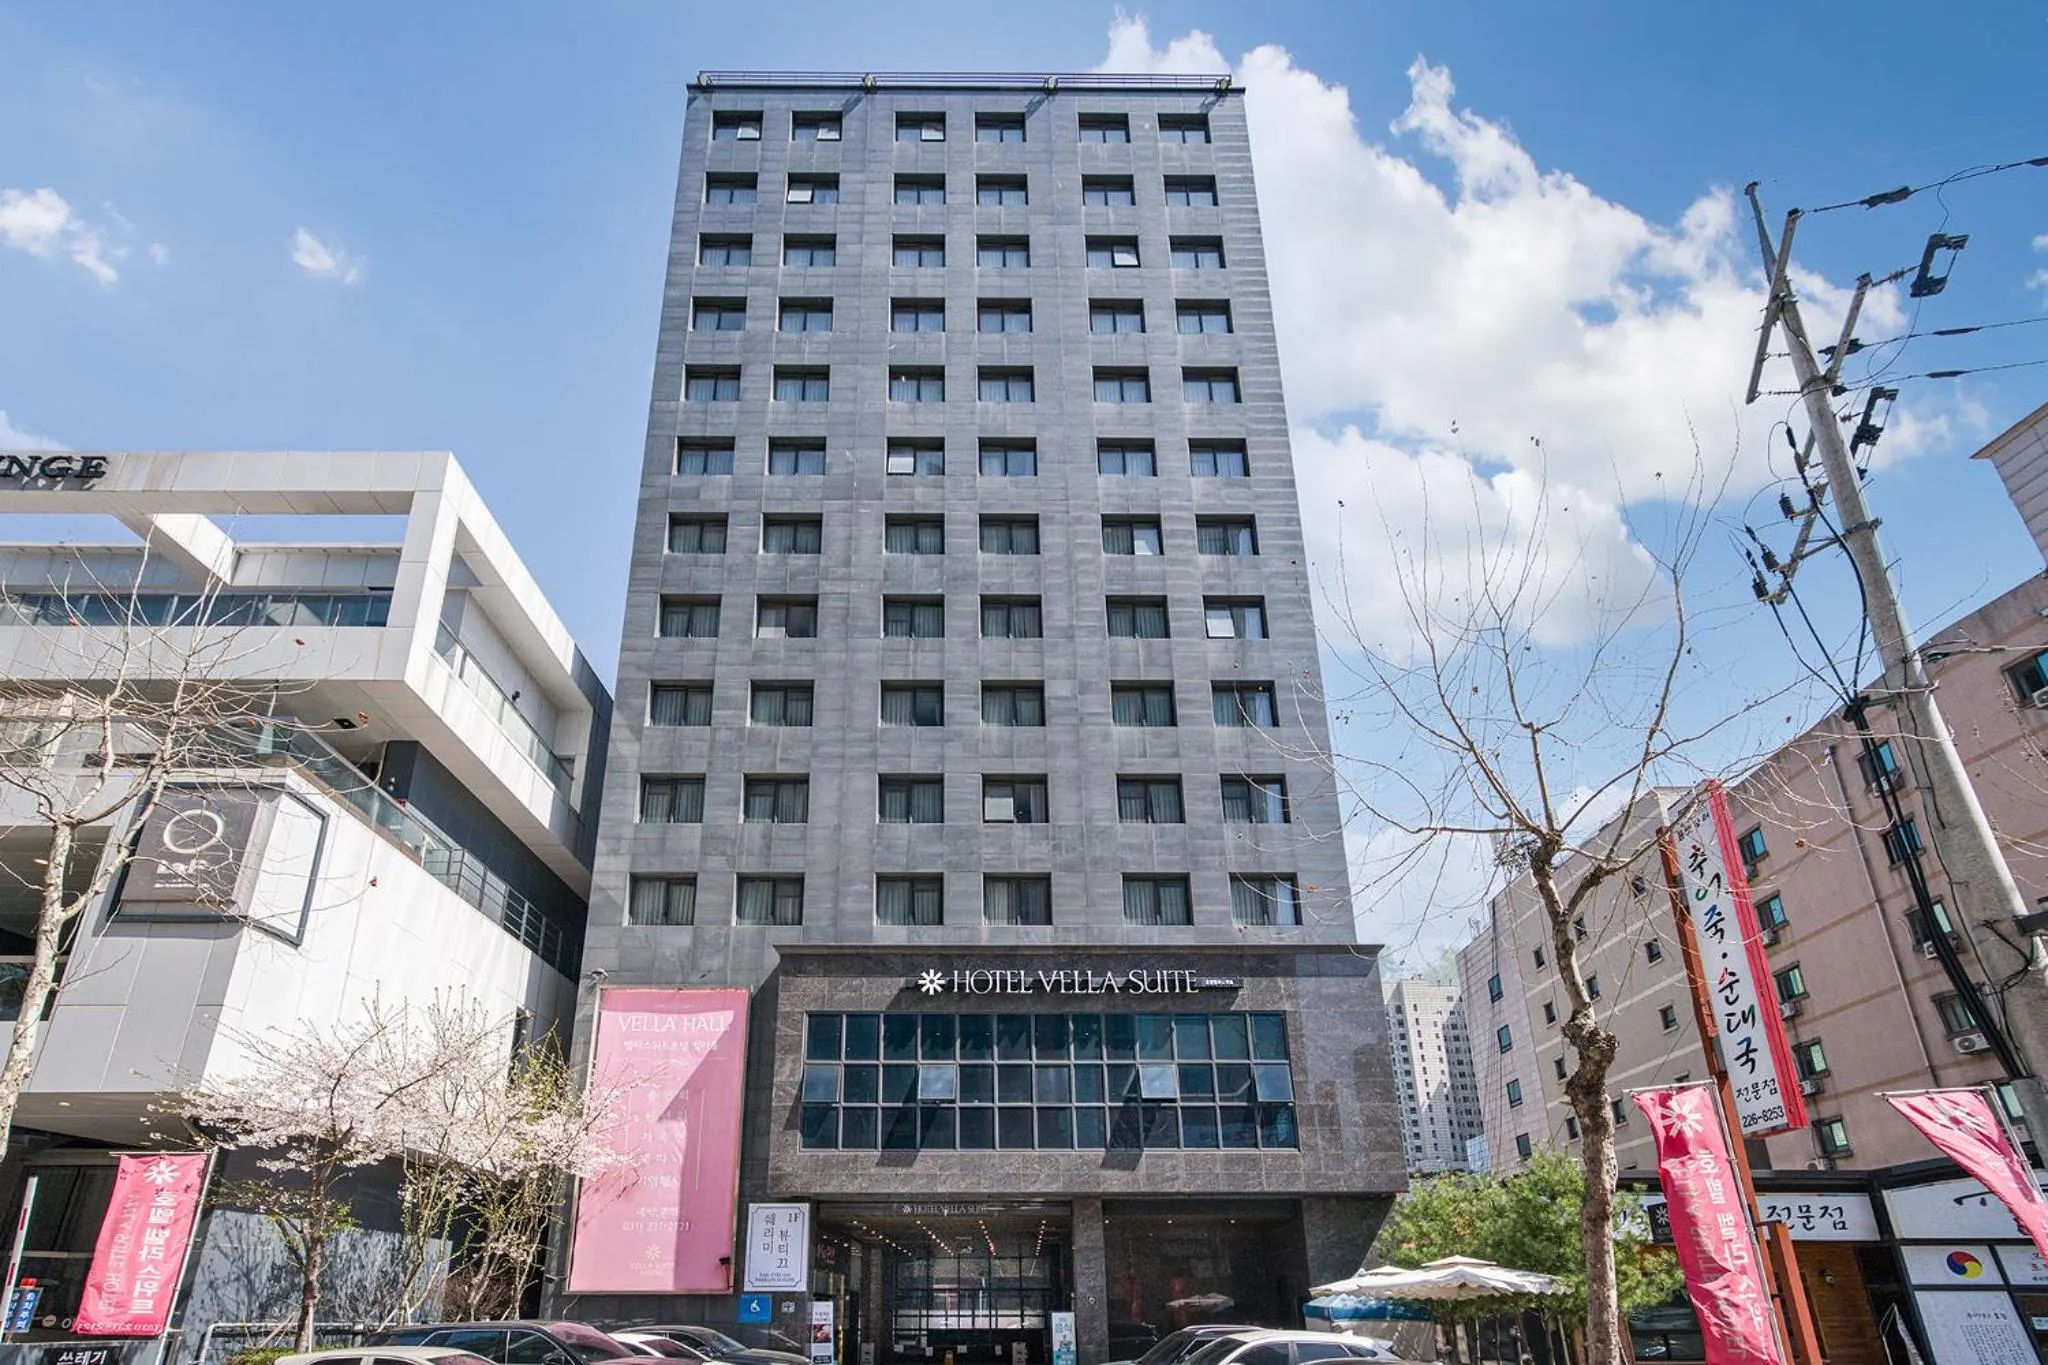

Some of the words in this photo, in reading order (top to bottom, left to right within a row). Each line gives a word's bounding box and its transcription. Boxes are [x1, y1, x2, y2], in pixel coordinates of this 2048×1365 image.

[0, 455, 109, 478] NGE
[952, 969, 1034, 994] HOTEL
[1037, 969, 1121, 994] VELLA
[1128, 969, 1200, 994] SUITE
[618, 1015, 677, 1032] VELLA
[683, 1015, 729, 1032] HALL
[1736, 1077, 1779, 1102] 전문점
[1742, 1105, 1785, 1128] 226-8253
[788, 1213, 801, 1223] 1F
[1767, 1204, 1848, 1231] 전문점
[57, 1349, 108, 1365] 쓰레기
